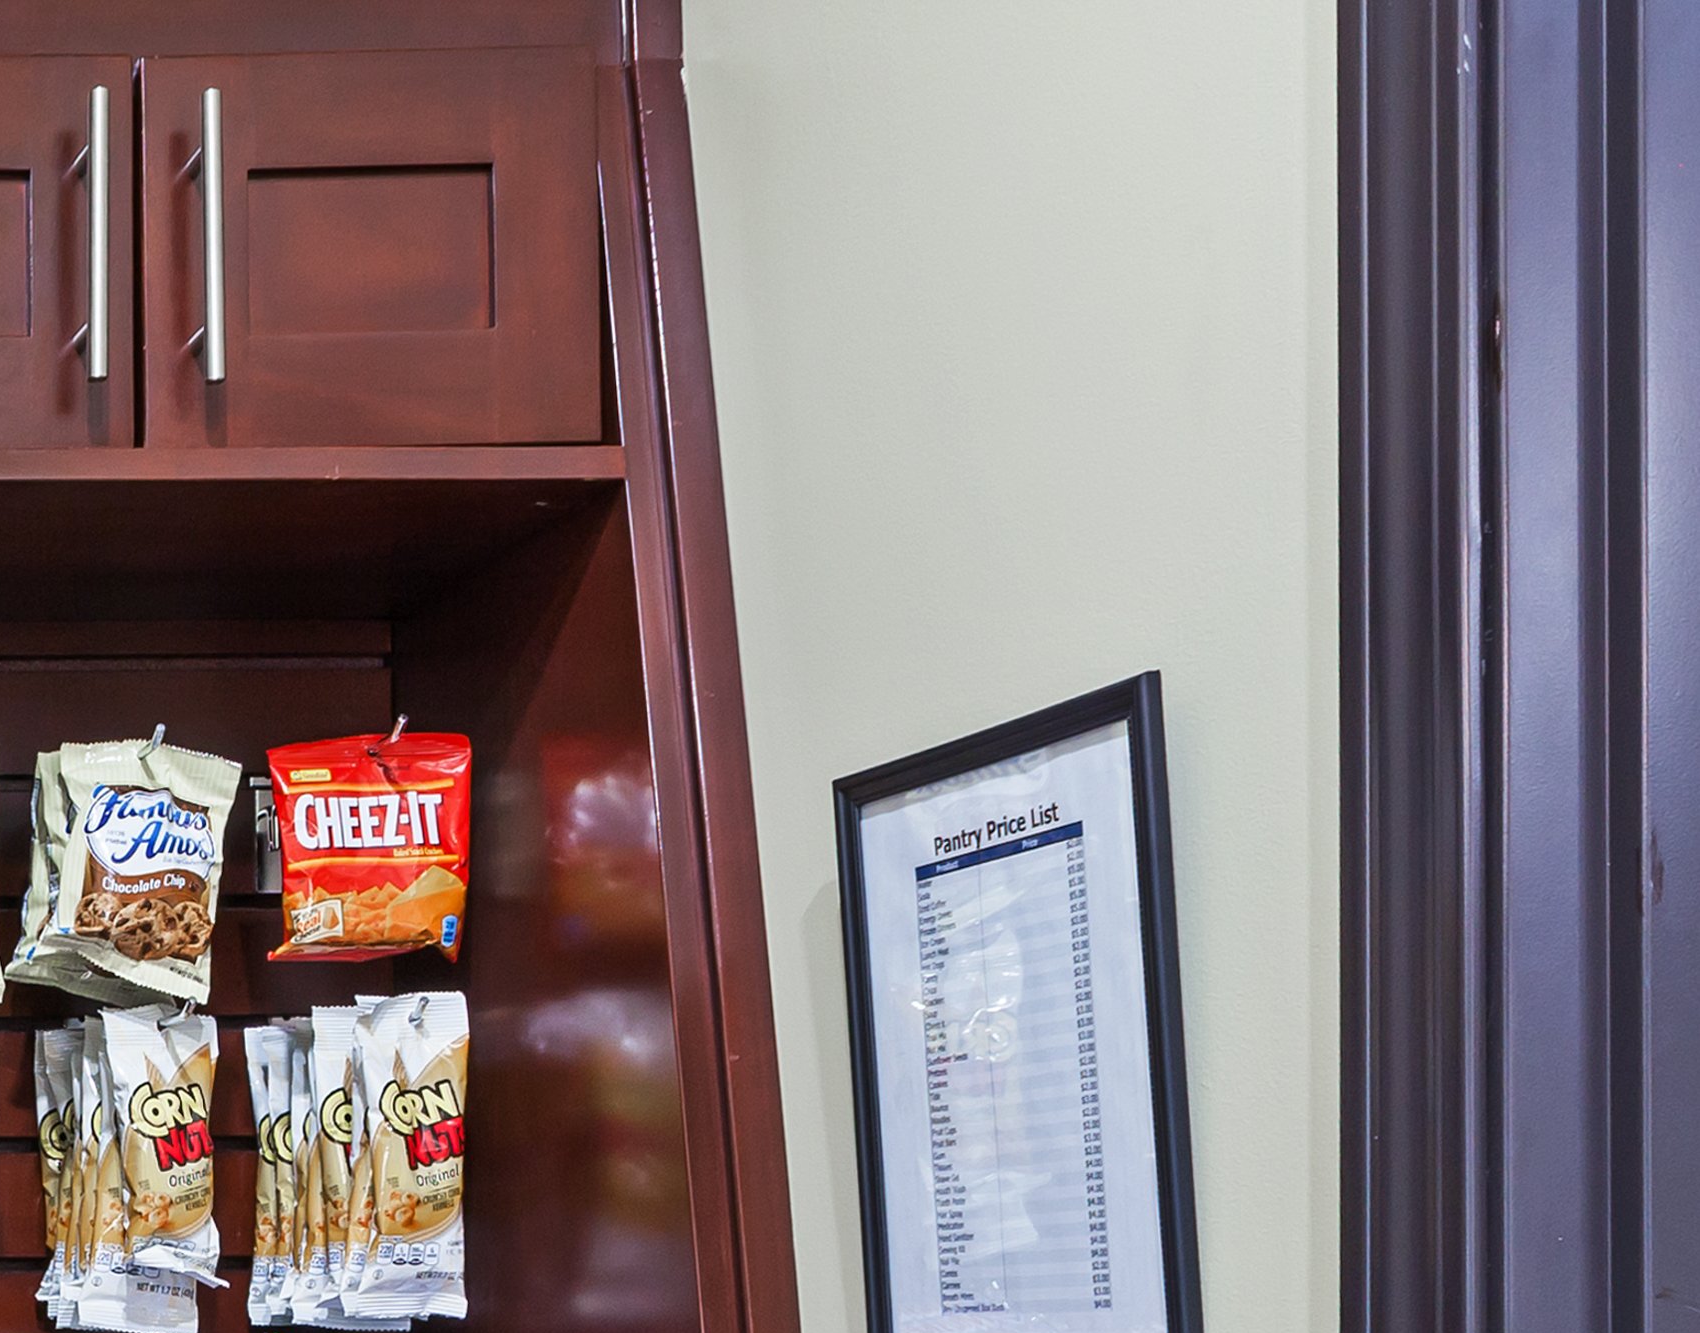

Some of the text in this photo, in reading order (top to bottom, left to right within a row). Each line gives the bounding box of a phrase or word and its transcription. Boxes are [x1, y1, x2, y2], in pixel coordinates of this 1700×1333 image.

[293, 791, 443, 850] CHEEZ-IT
[934, 802, 1060, 856] Pantry Price List
[378, 1079, 460, 1136] CORN
[406, 1116, 464, 1170] NUTS
[417, 1167, 460, 1187] Original
